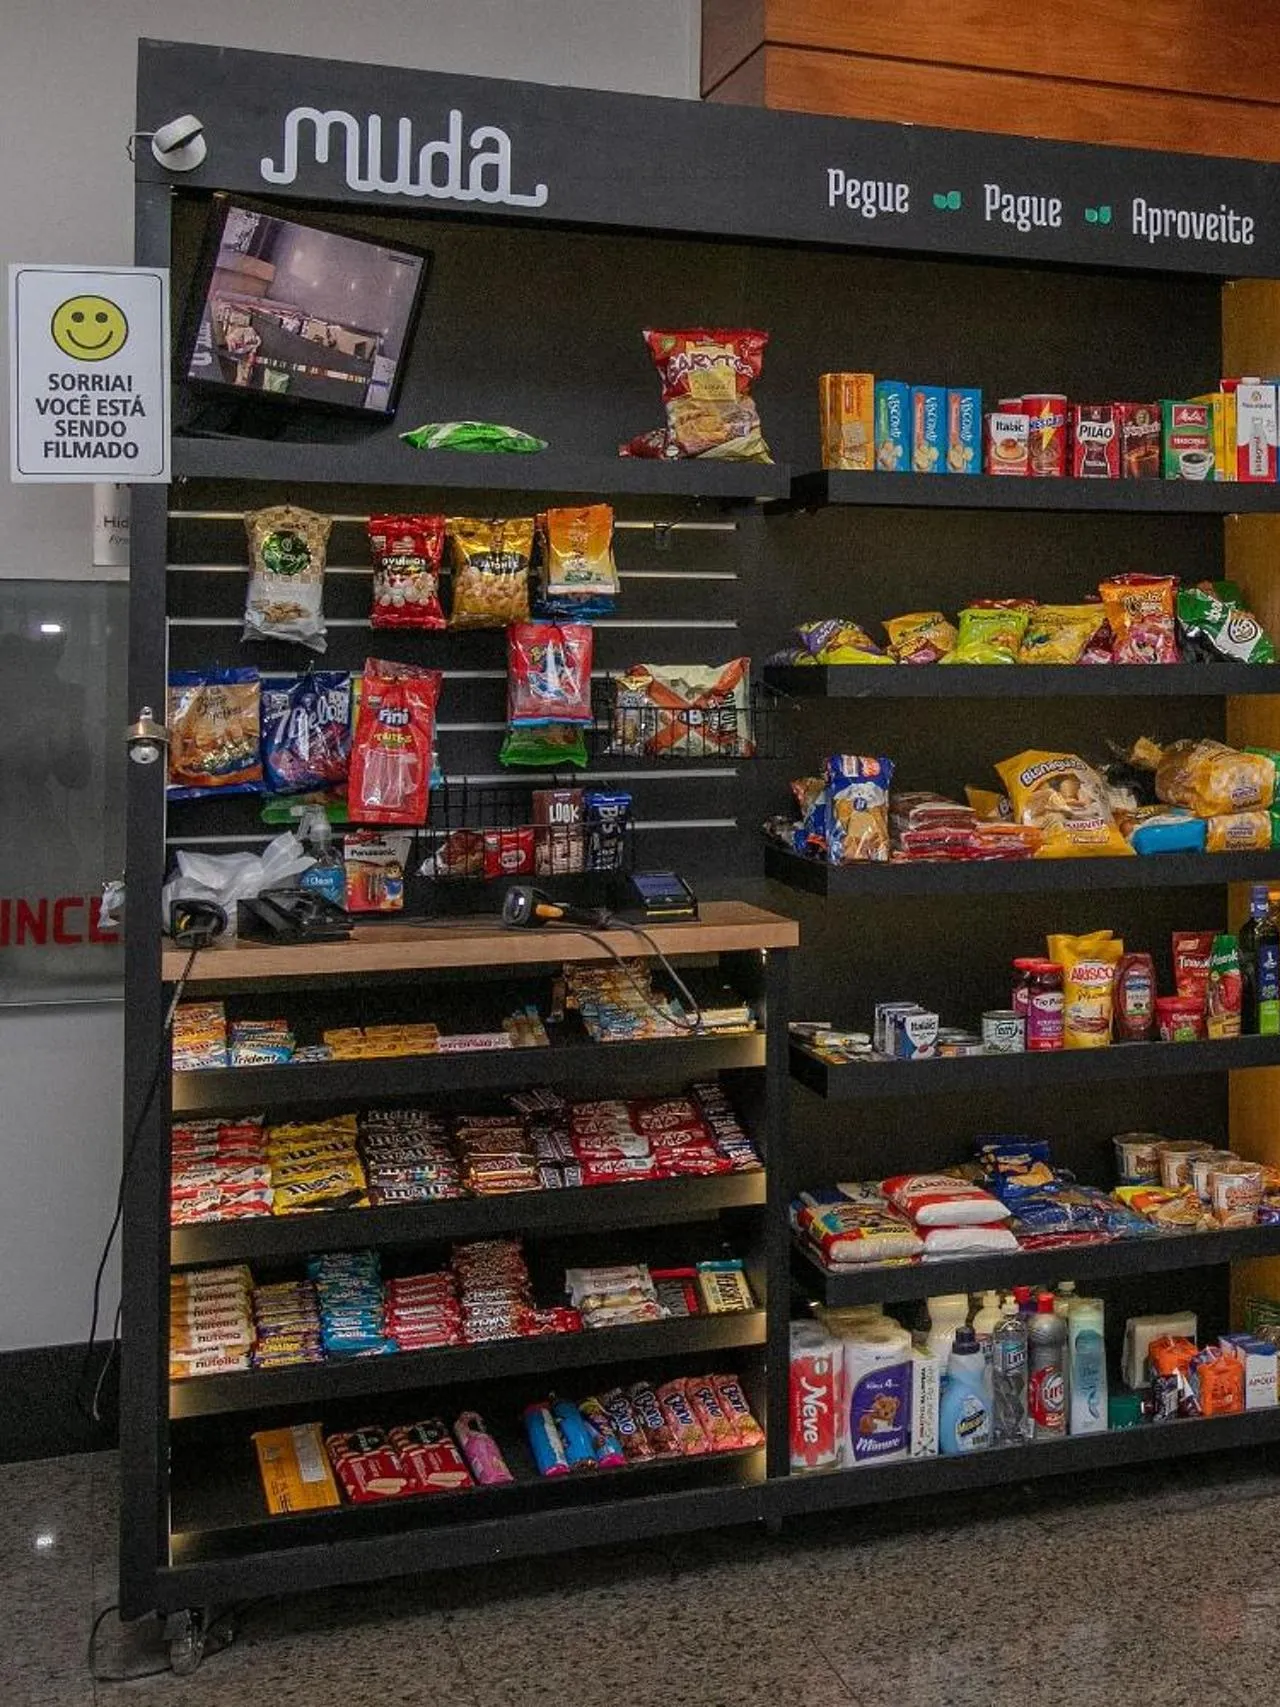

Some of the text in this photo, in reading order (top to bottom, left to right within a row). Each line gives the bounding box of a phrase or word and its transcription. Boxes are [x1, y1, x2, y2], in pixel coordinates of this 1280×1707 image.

[260, 107, 549, 207] muda
[827, 168, 1255, 245] Pegue Pague Aproveite
[48, 373, 133, 392] SORRIA!
[35, 394, 146, 417] VOCÊ ESTÁ
[55, 420, 127, 437] SENDO
[44, 441, 139, 459] FILMADO
[378, 707, 409, 725] Fini
[549, 802, 580, 823] LOOK
[232, 1054, 277, 1065] Trident
[196, 1356, 240, 1368] nutella
[801, 1376, 828, 1443] Neve
